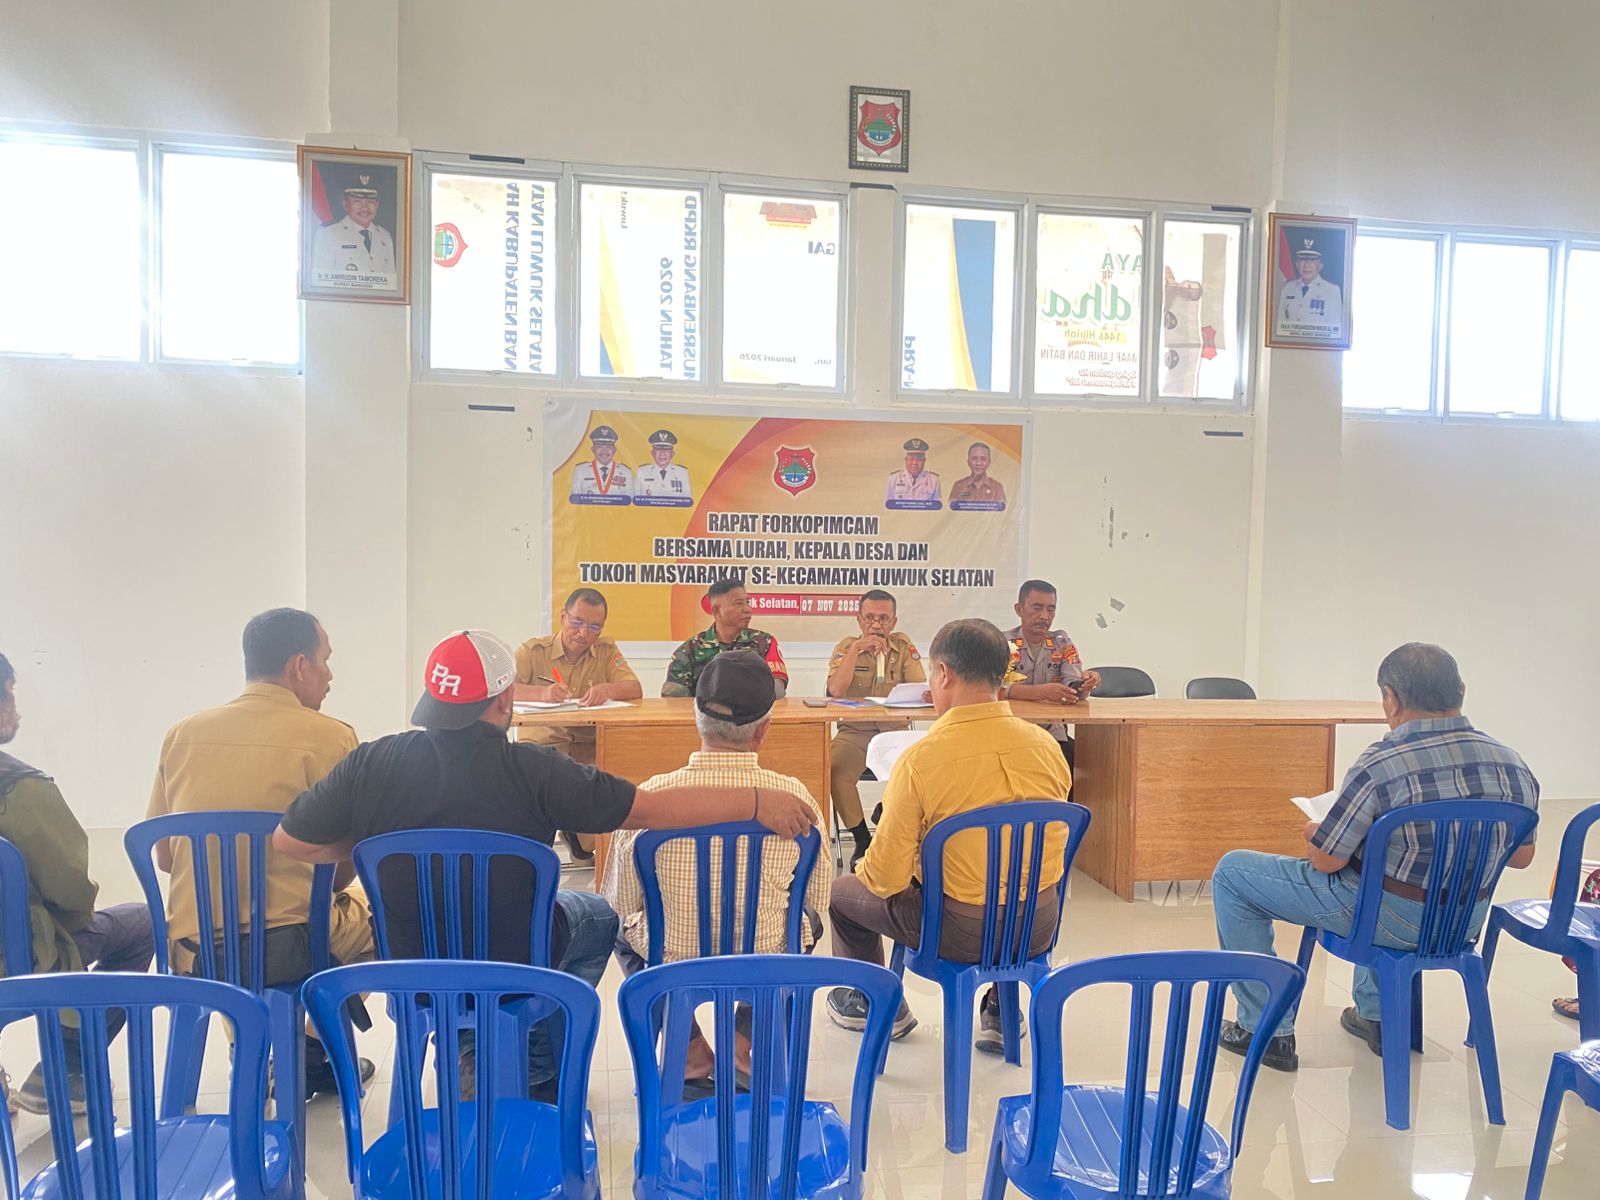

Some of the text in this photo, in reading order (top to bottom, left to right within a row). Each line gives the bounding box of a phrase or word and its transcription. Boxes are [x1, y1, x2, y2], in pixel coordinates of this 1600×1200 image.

[708, 513, 878, 535] RAPAT FORKOPIMCAM
[654, 538, 928, 561] BERSAMA LURAH, KEPALA DESA DAN
[580, 563, 994, 587] TOKOH MASYARAKAT SE-KECAMATAN LUWUK SELATAN
[759, 597, 799, 610] Selatan,
[801, 600, 812, 612] 07
[817, 600, 833, 612] NOV
[837, 600, 860, 612] 2025
